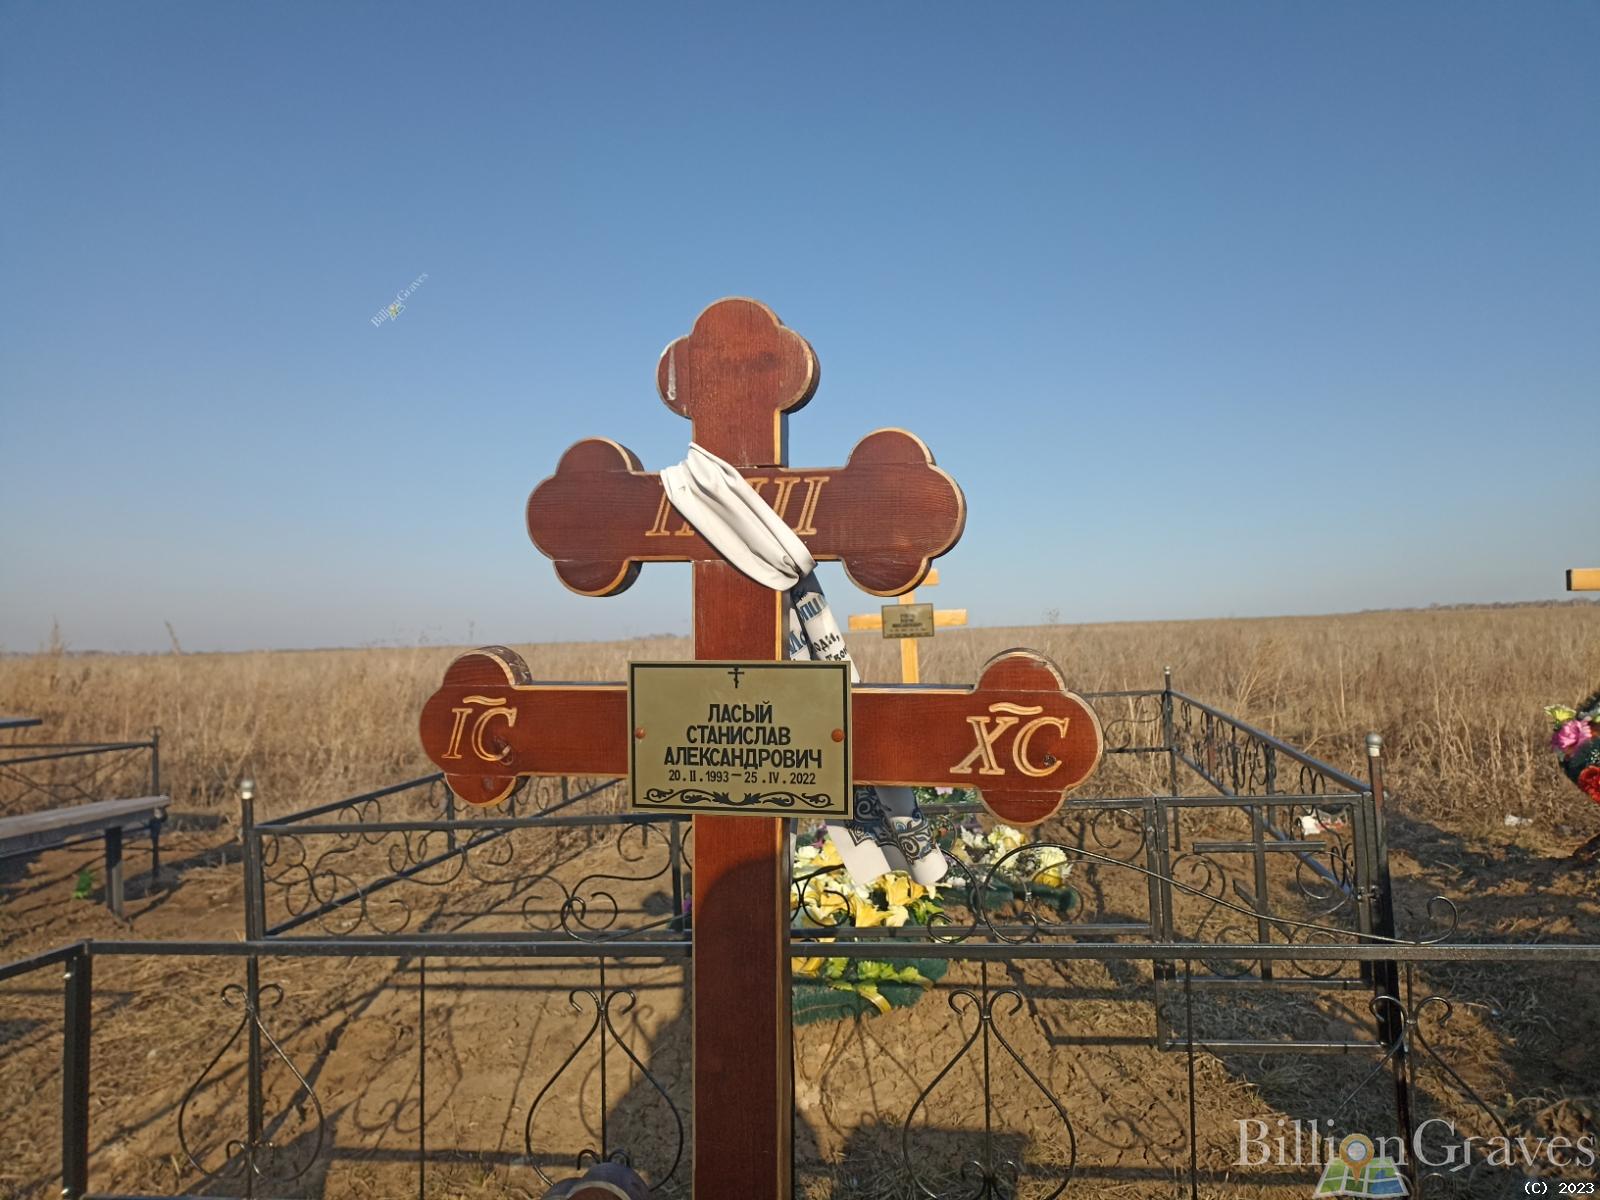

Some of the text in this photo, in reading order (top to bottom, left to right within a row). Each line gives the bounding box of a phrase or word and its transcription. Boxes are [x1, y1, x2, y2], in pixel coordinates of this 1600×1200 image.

[707, 700, 773, 724] ЛАСЫЙ
[686, 725, 791, 746] СТАНИСЛАВ
[664, 746, 823, 770] АЛЕКСАНДРОВИЧ
